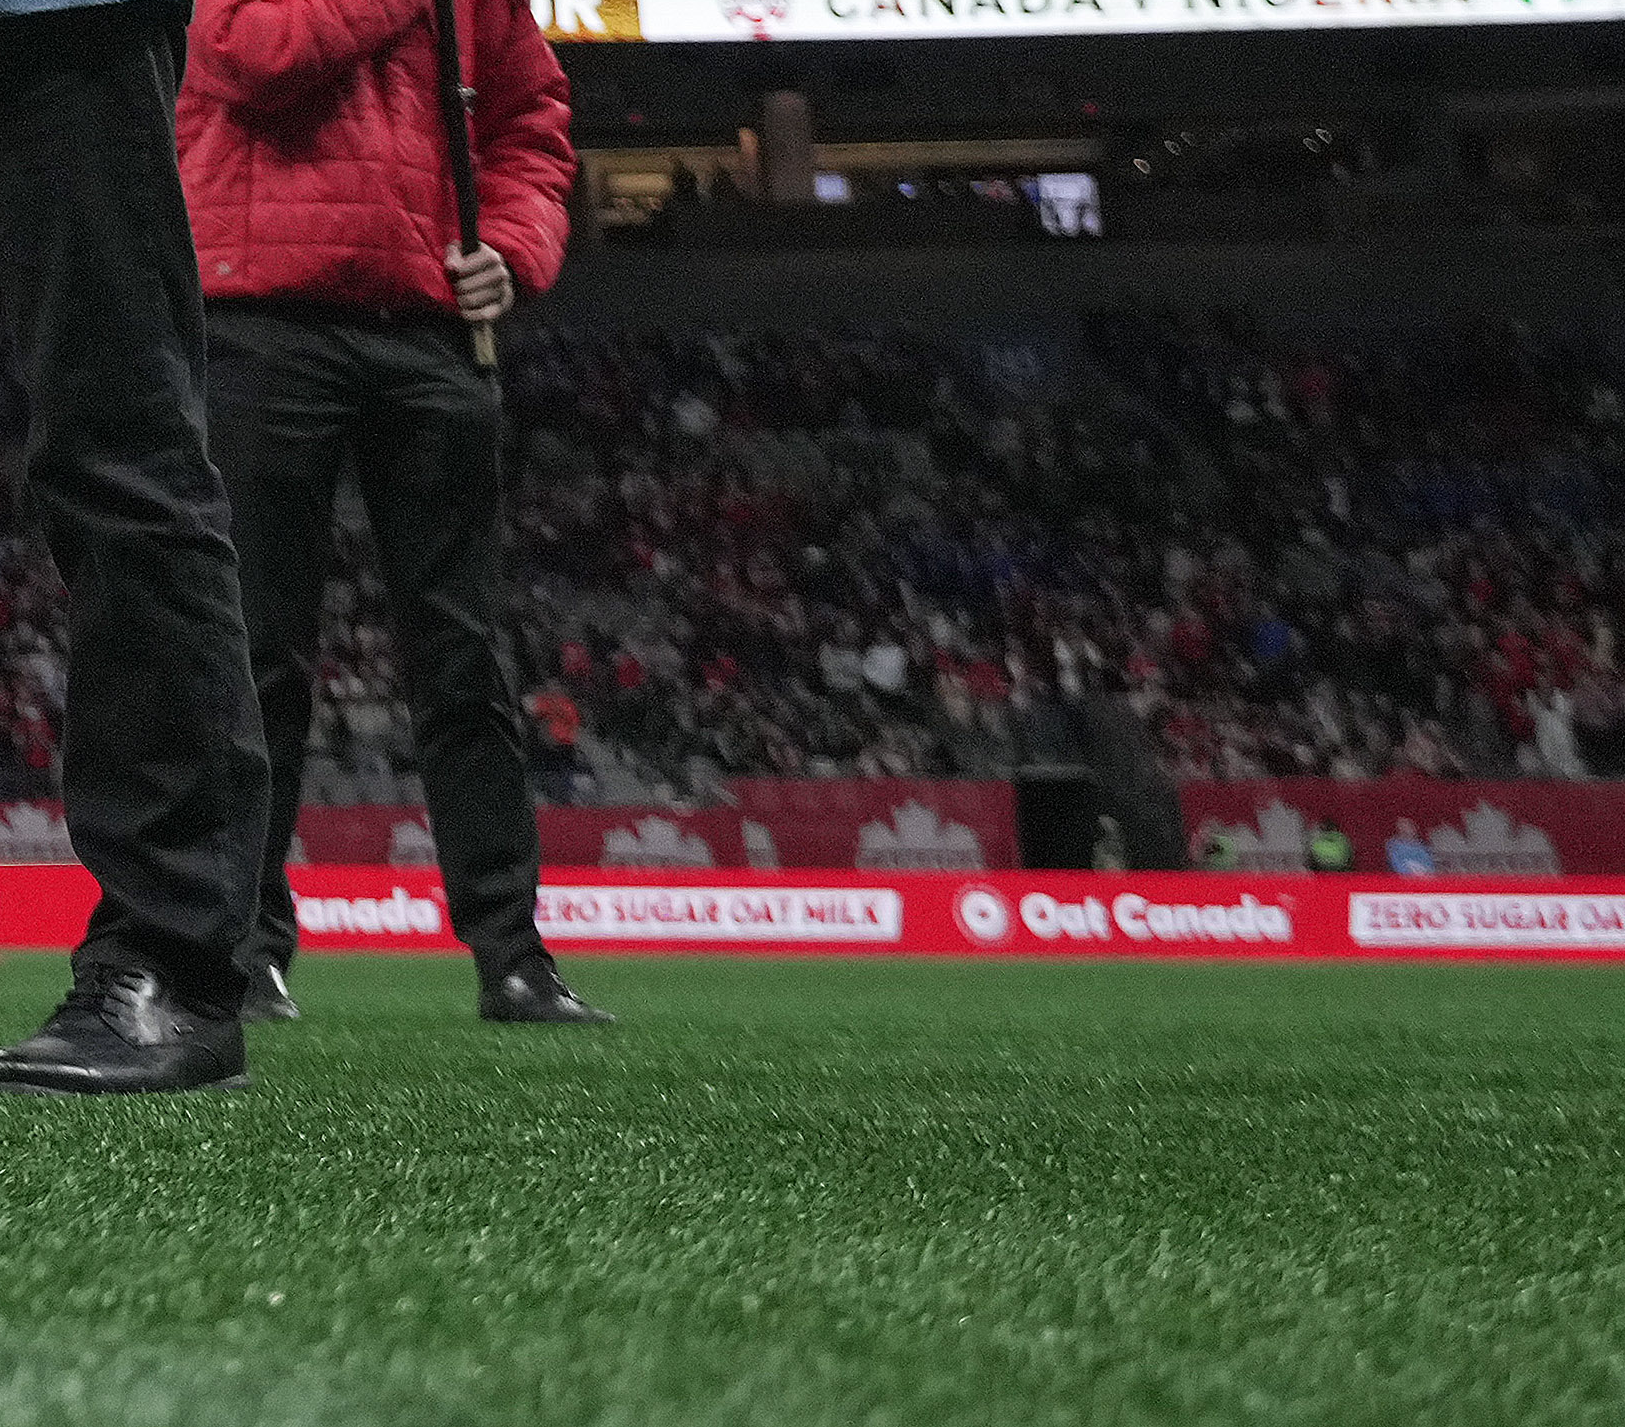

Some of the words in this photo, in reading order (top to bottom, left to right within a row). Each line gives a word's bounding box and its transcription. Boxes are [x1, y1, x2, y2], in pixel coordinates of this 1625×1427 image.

[293, 887, 442, 934] anada
[1020, 892, 1113, 941] Oat
[1113, 893, 1295, 943] Canada
